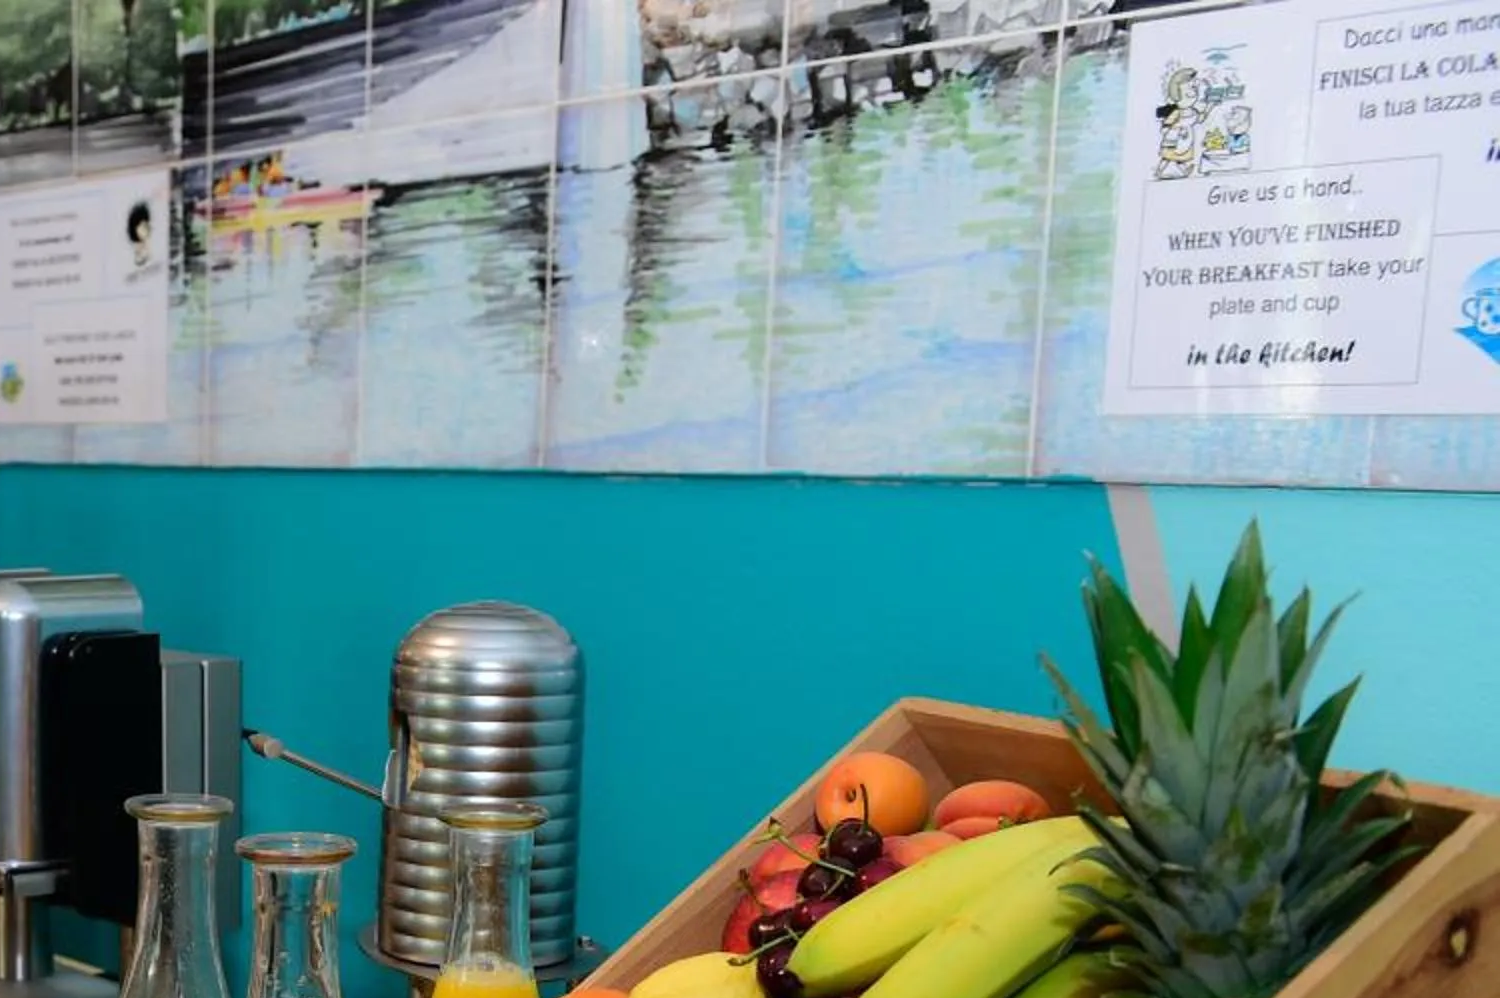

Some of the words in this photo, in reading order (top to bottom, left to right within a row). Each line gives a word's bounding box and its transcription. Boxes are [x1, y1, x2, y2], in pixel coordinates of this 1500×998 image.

[1344, 21, 1403, 49] Dacci
[1411, 20, 1449, 40] una
[1318, 63, 1395, 91] FINISCI
[1400, 61, 1430, 82] LA
[1359, 101, 1378, 120] la
[1384, 99, 1417, 118] tua
[1423, 91, 1483, 113] tazza
[1207, 184, 1250, 206] Give
[1256, 184, 1278, 202] us
[1283, 184, 1296, 200] a
[1168, 230, 1222, 251] WHEN
[1228, 224, 1299, 249] YOU'VE
[1304, 218, 1402, 243] FINISHED
[1142, 266, 1193, 288] YOUR
[1198, 260, 1325, 285] BREAKFAST
[1328, 256, 1371, 277] take
[1377, 255, 1425, 281] your
[1209, 298, 1255, 319] plate
[1261, 293, 1298, 314] and
[1303, 294, 1340, 315] cup
[1187, 343, 1209, 366] in
[1215, 342, 1253, 366] the
[1258, 339, 1357, 369] kitchen!
